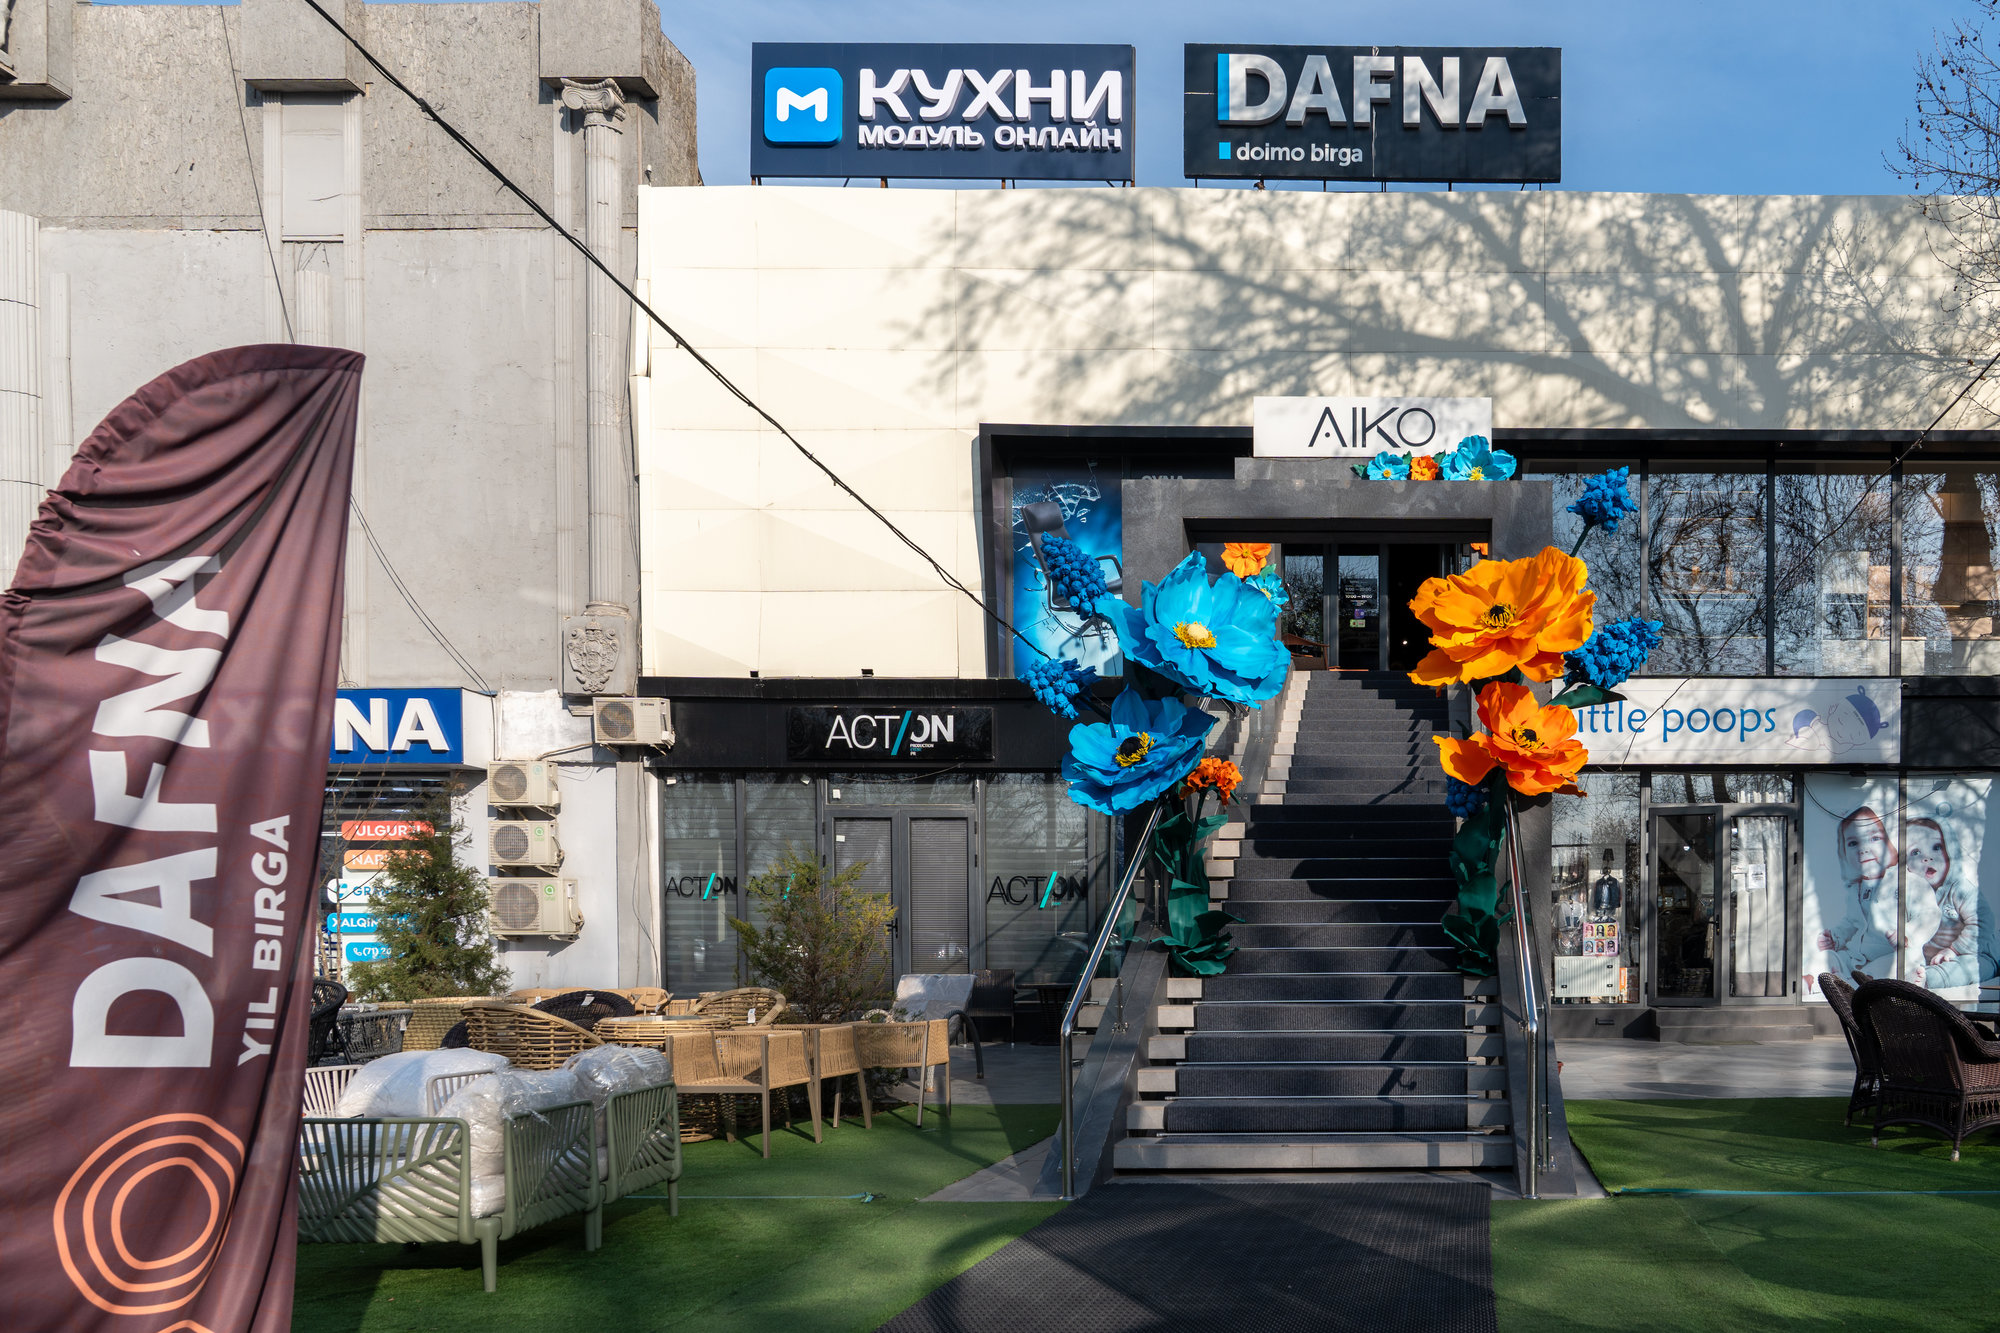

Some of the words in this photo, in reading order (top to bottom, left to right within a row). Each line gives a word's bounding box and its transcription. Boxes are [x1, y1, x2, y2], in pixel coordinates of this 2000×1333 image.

[859, 68, 1123, 123] КУХНИ
[1217, 53, 1527, 127] DAFNA
[858, 124, 985, 149] МОДУЛЬ
[994, 120, 1123, 150] ОНЛАЙН
[1236, 142, 1305, 162] doimo
[1311, 143, 1363, 166] birga
[1308, 406, 1436, 448] AIKO
[1577, 700, 1647, 733] ittle
[1662, 707, 1776, 742] poops
[70, 555, 230, 1067] DAFNA
[250, 814, 291, 971] BIRGA
[237, 987, 279, 1067] YIL
